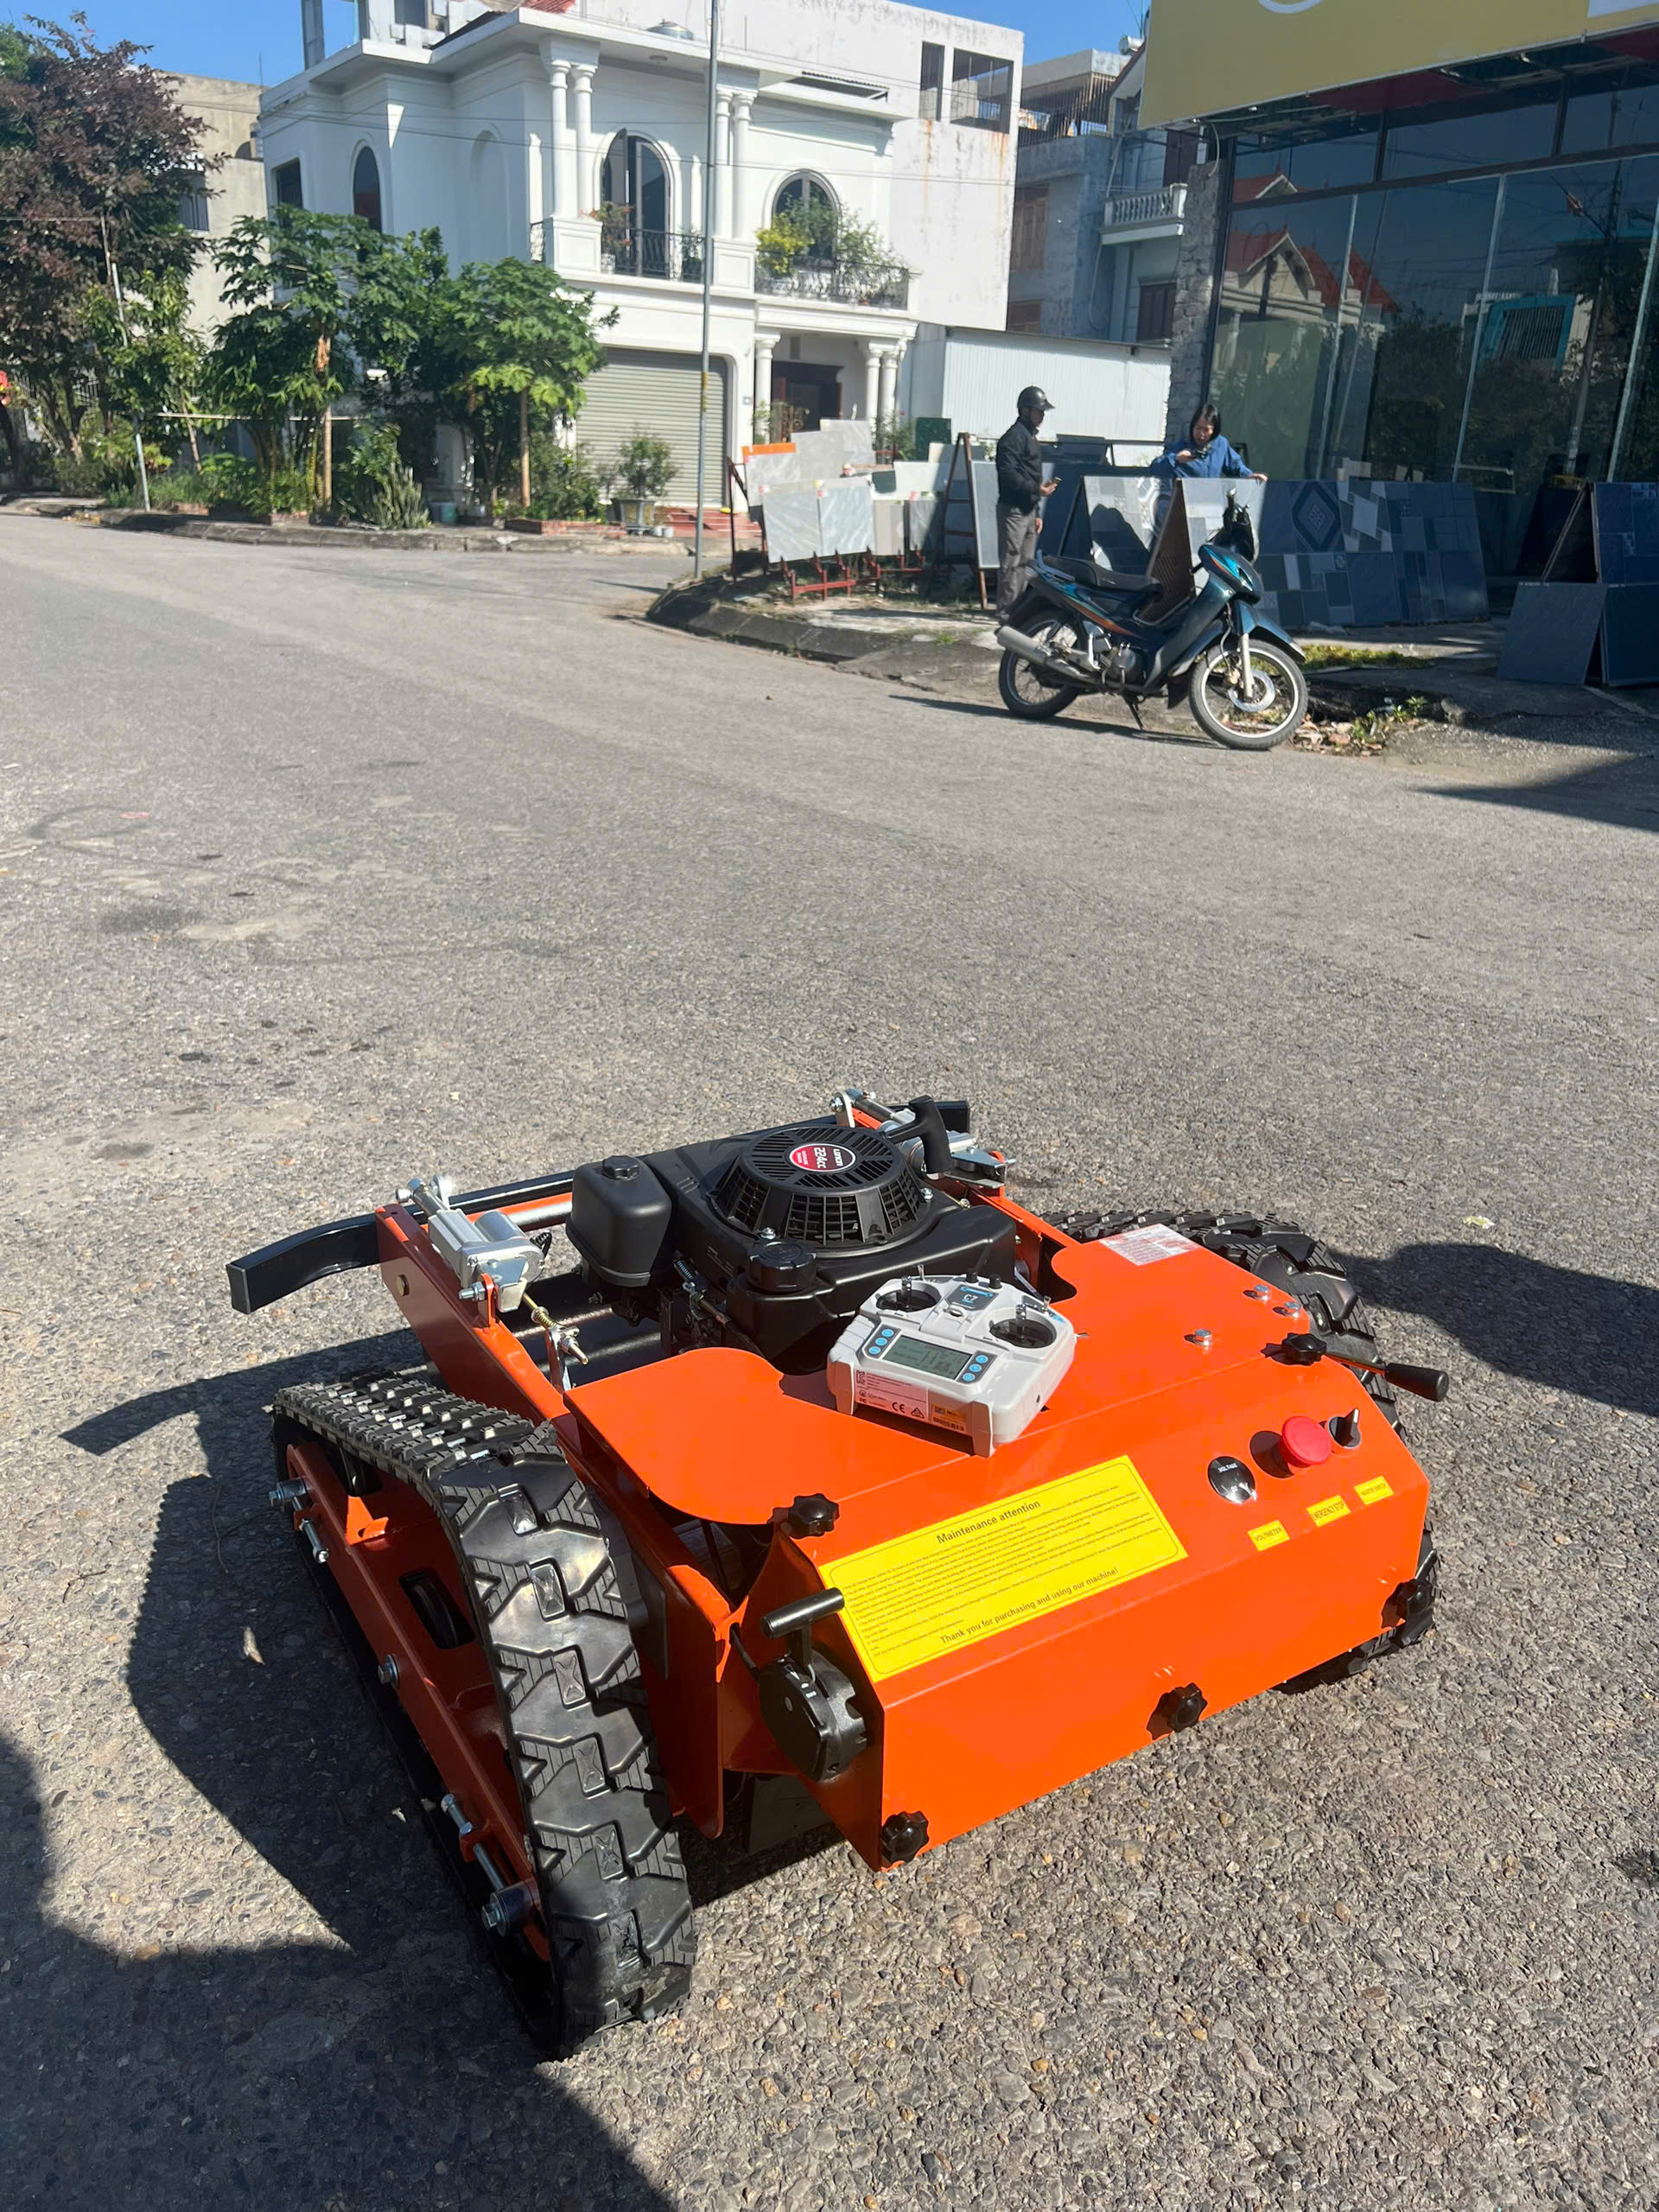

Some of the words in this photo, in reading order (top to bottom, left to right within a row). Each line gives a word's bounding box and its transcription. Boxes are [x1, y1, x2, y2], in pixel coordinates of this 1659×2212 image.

[892, 1402, 906, 1414] CE
[936, 1516, 997, 1543] Maintenance
[999, 1501, 1041, 1521] attention
[940, 1629, 966, 1644] Thank
[966, 1624, 982, 1635] you
[982, 1618, 994, 1627] for
[994, 1601, 1036, 1624] purchasing
[1036, 1594, 1051, 1605] and
[1052, 1586, 1072, 1600] using
[1072, 1581, 1086, 1591] our
[1085, 1567, 1119, 1586] machine!
